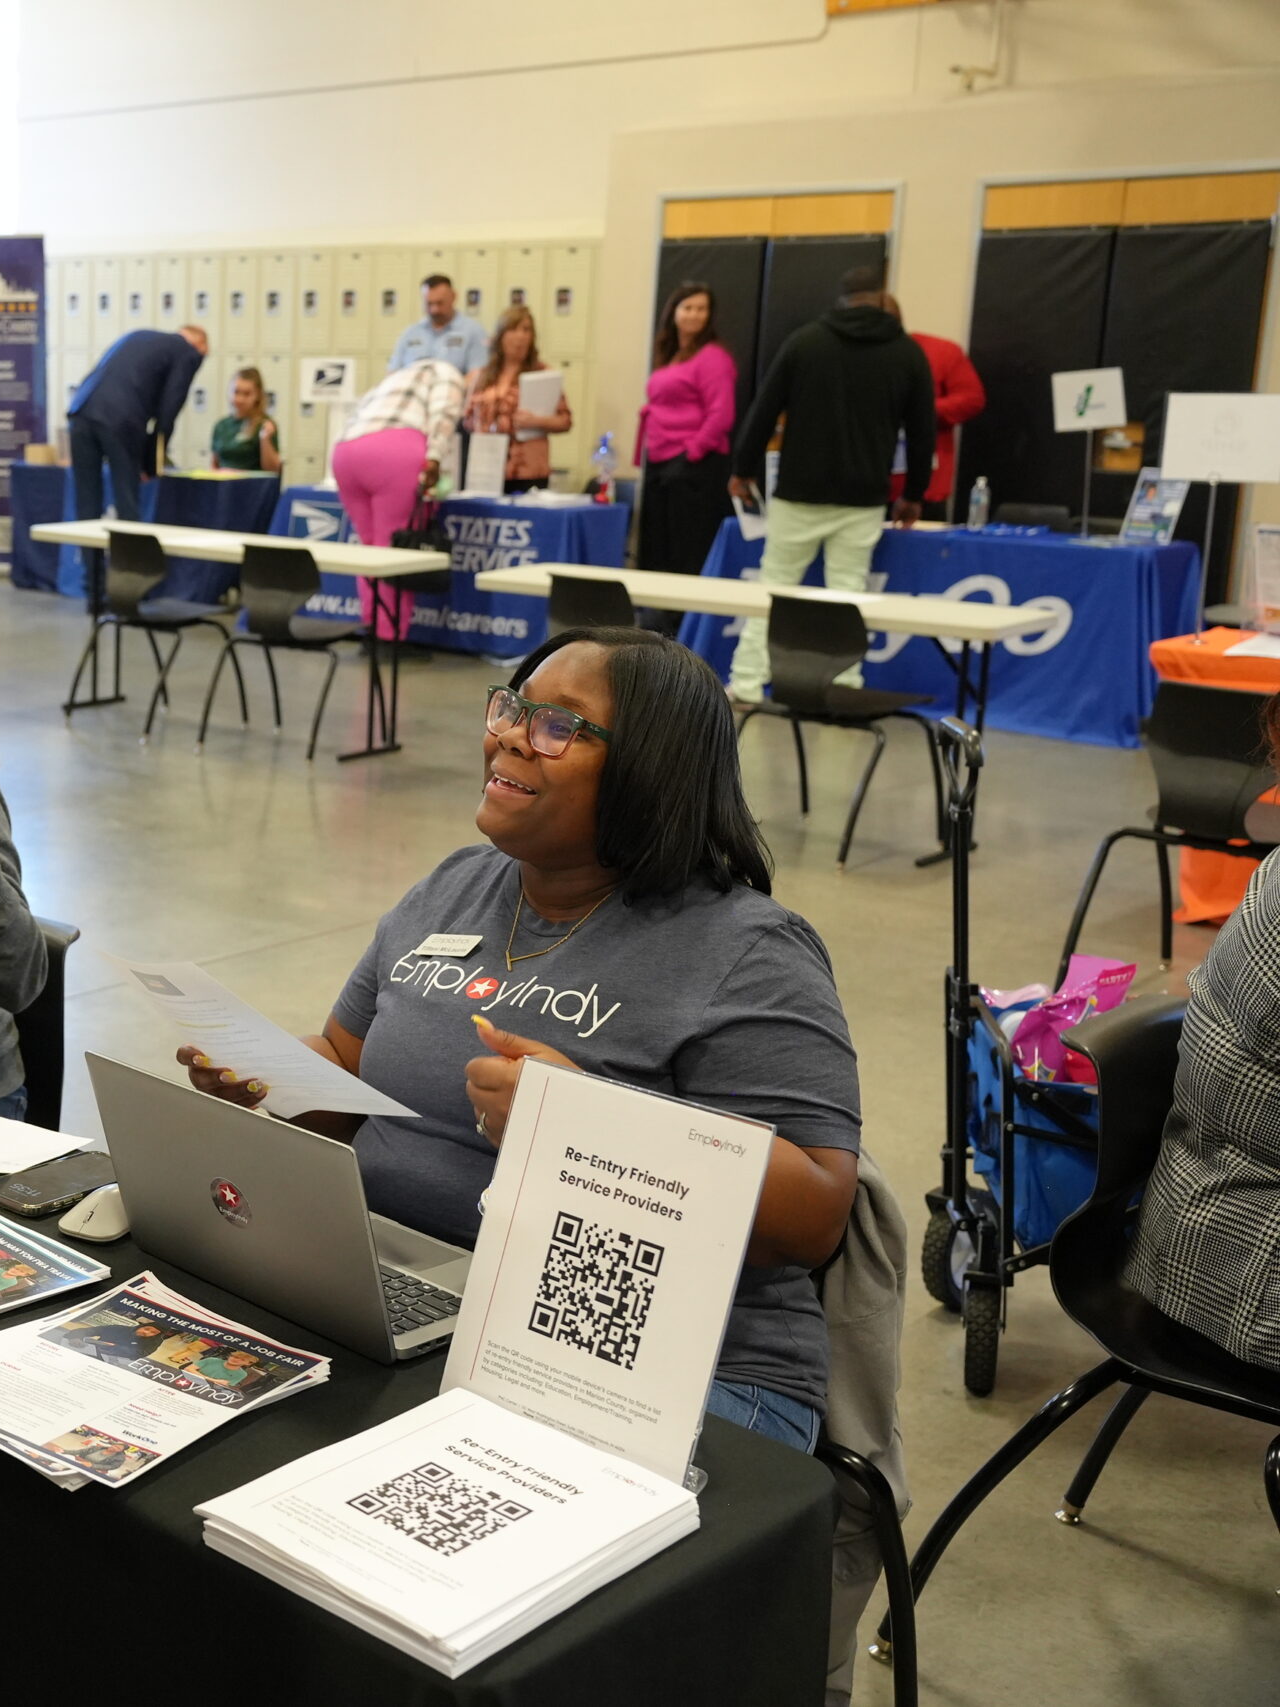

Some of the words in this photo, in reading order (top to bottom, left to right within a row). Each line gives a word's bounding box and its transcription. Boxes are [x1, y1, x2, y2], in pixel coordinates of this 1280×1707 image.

[444, 515, 533, 547] STATES
[451, 544, 538, 573] ERVICE
[390, 949, 621, 1038] EmployIndy
[688, 1128, 747, 1157] EmployIndy
[559, 1170, 611, 1197] Service
[613, 1188, 683, 1221] Providers
[565, 1146, 628, 1180] Re-Entry
[629, 1167, 690, 1200] Friendly
[120, 1297, 168, 1319] MAKING
[168, 1315, 189, 1328] THE
[189, 1323, 223, 1338] MOST
[223, 1334, 242, 1344] OF
[239, 1340, 251, 1348] A
[250, 1343, 276, 1358] JOB
[275, 1353, 305, 1367] FAIR
[127, 1358, 243, 1405] EmployIndy
[487, 1340, 500, 1349] Scan
[520, 1353, 533, 1363] code
[534, 1359, 549, 1369] using
[550, 1365, 562, 1374] your
[563, 1370, 582, 1382] mobile
[490, 1359, 517, 1375] categories
[504, 1374, 519, 1385] Legal
[520, 1381, 530, 1389] and
[512, 1359, 532, 1372] friendly
[533, 1368, 552, 1380] service
[553, 1376, 578, 1391] providers
[585, 1389, 605, 1402] Marion
[628, 1407, 658, 1423] organized
[444, 1445, 497, 1472] Service
[497, 1470, 567, 1504] Providers
[460, 1437, 523, 1469] Re-Entry
[523, 1466, 584, 1496] Friendly
